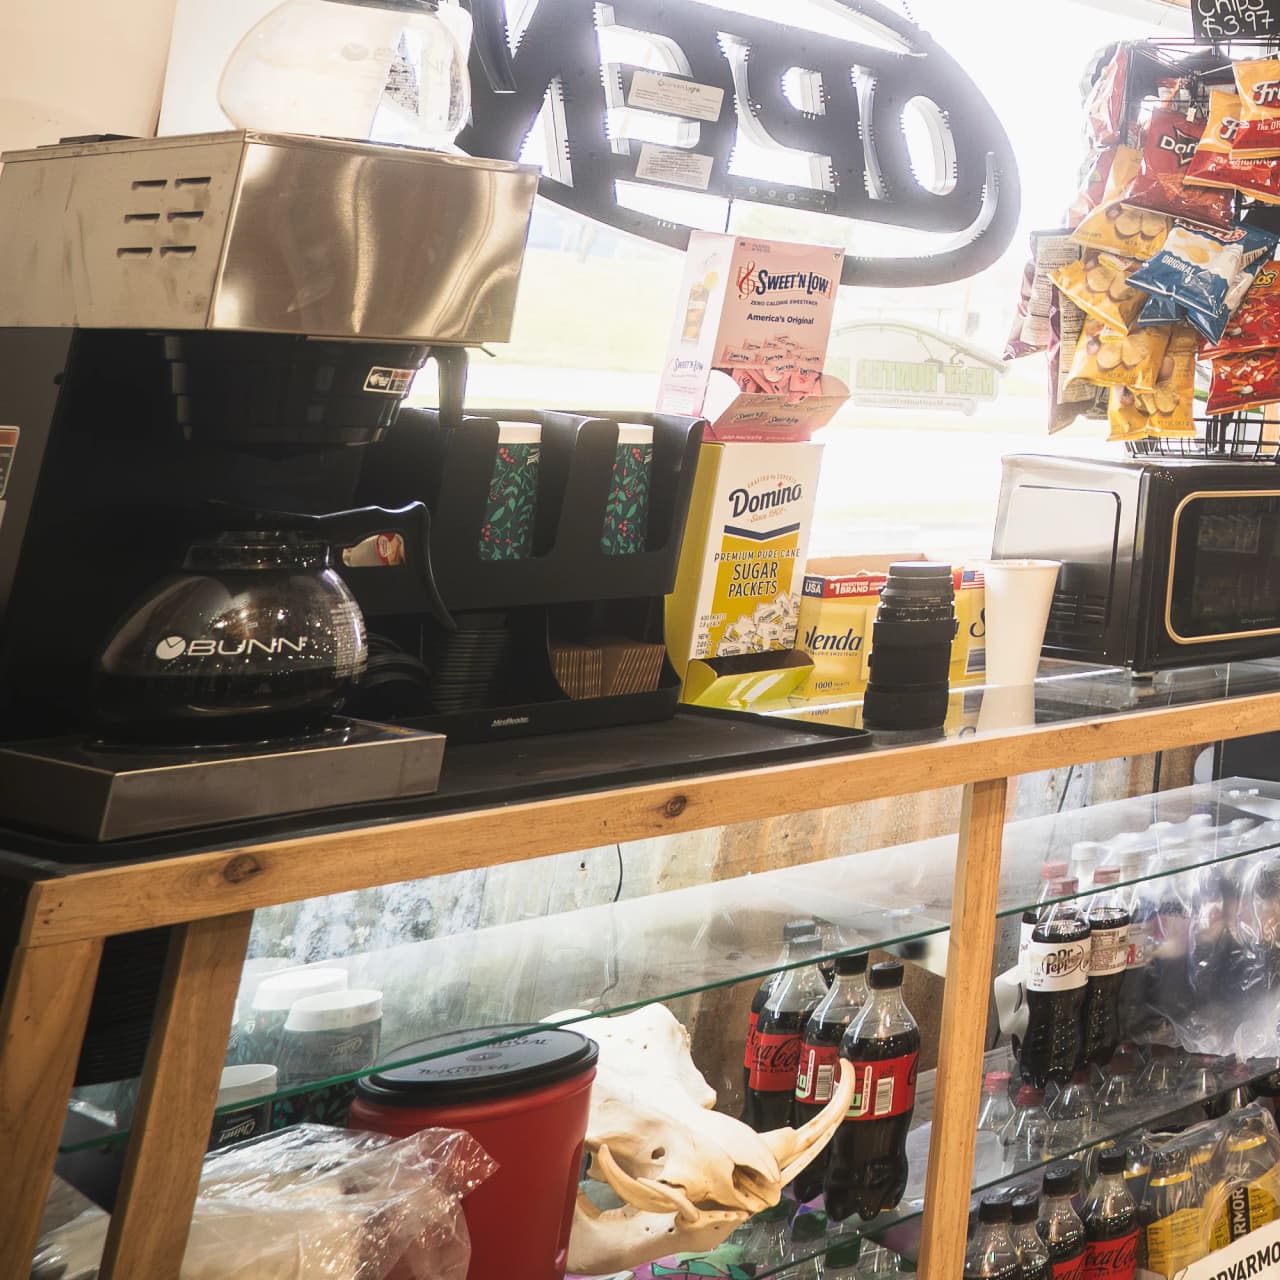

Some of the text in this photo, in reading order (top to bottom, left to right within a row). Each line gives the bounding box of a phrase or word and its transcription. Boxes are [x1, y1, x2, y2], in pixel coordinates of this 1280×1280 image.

[1201, 10, 1275, 38] $3.97
[807, 271, 830, 295] LOW
[746, 312, 815, 326] America's Original
[728, 481, 803, 519] Domino
[714, 548, 801, 563] PREMIUM PURE CANE
[733, 562, 779, 581] SUGAR
[728, 580, 777, 598] PACKETS
[804, 582, 822, 594] USA
[187, 635, 307, 657] BUNN
